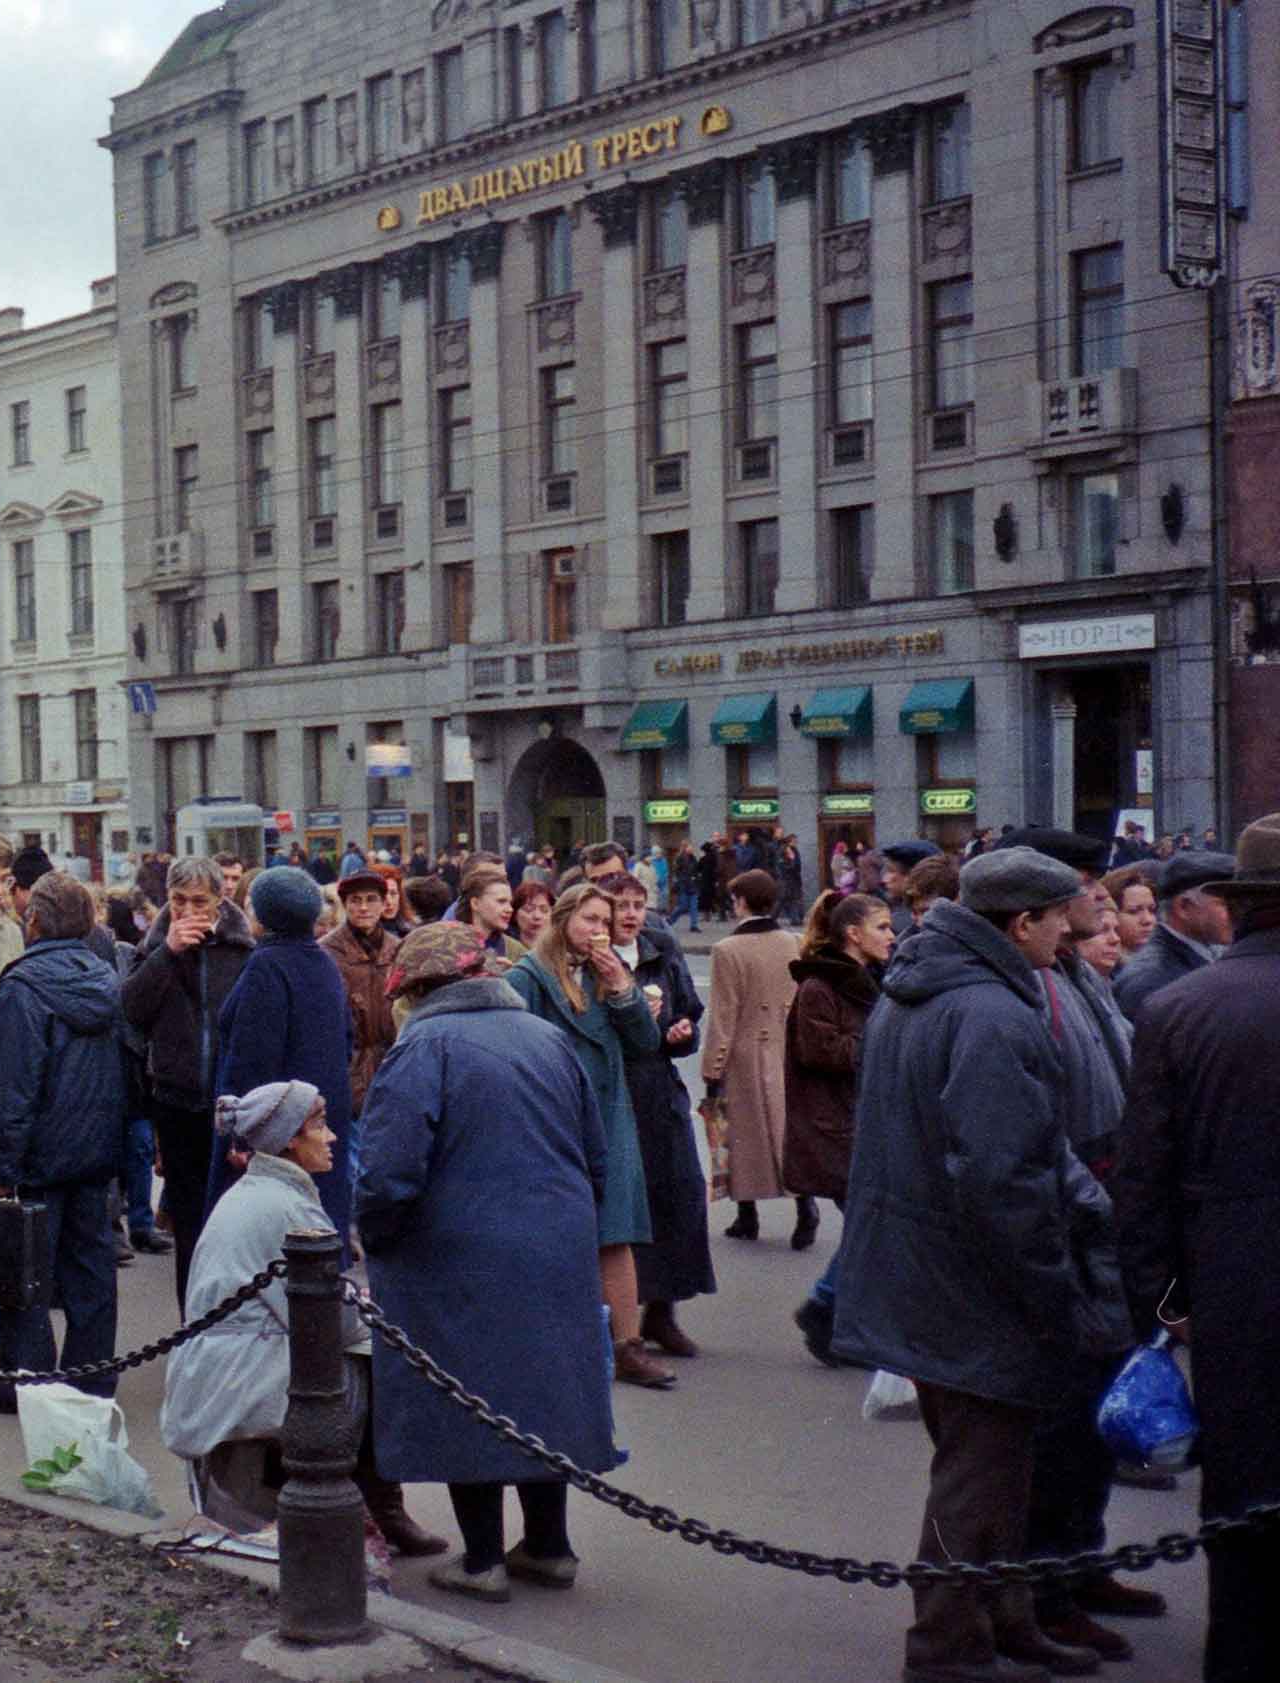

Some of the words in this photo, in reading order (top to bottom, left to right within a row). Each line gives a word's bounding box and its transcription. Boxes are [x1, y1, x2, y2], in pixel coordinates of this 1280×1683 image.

[415, 140, 584, 224] ДВАДЦАТЫЙ
[592, 115, 681, 169] ТРЕСТ
[654, 651, 721, 676] САЛОН
[926, 794, 970, 809] СЕВЕР
